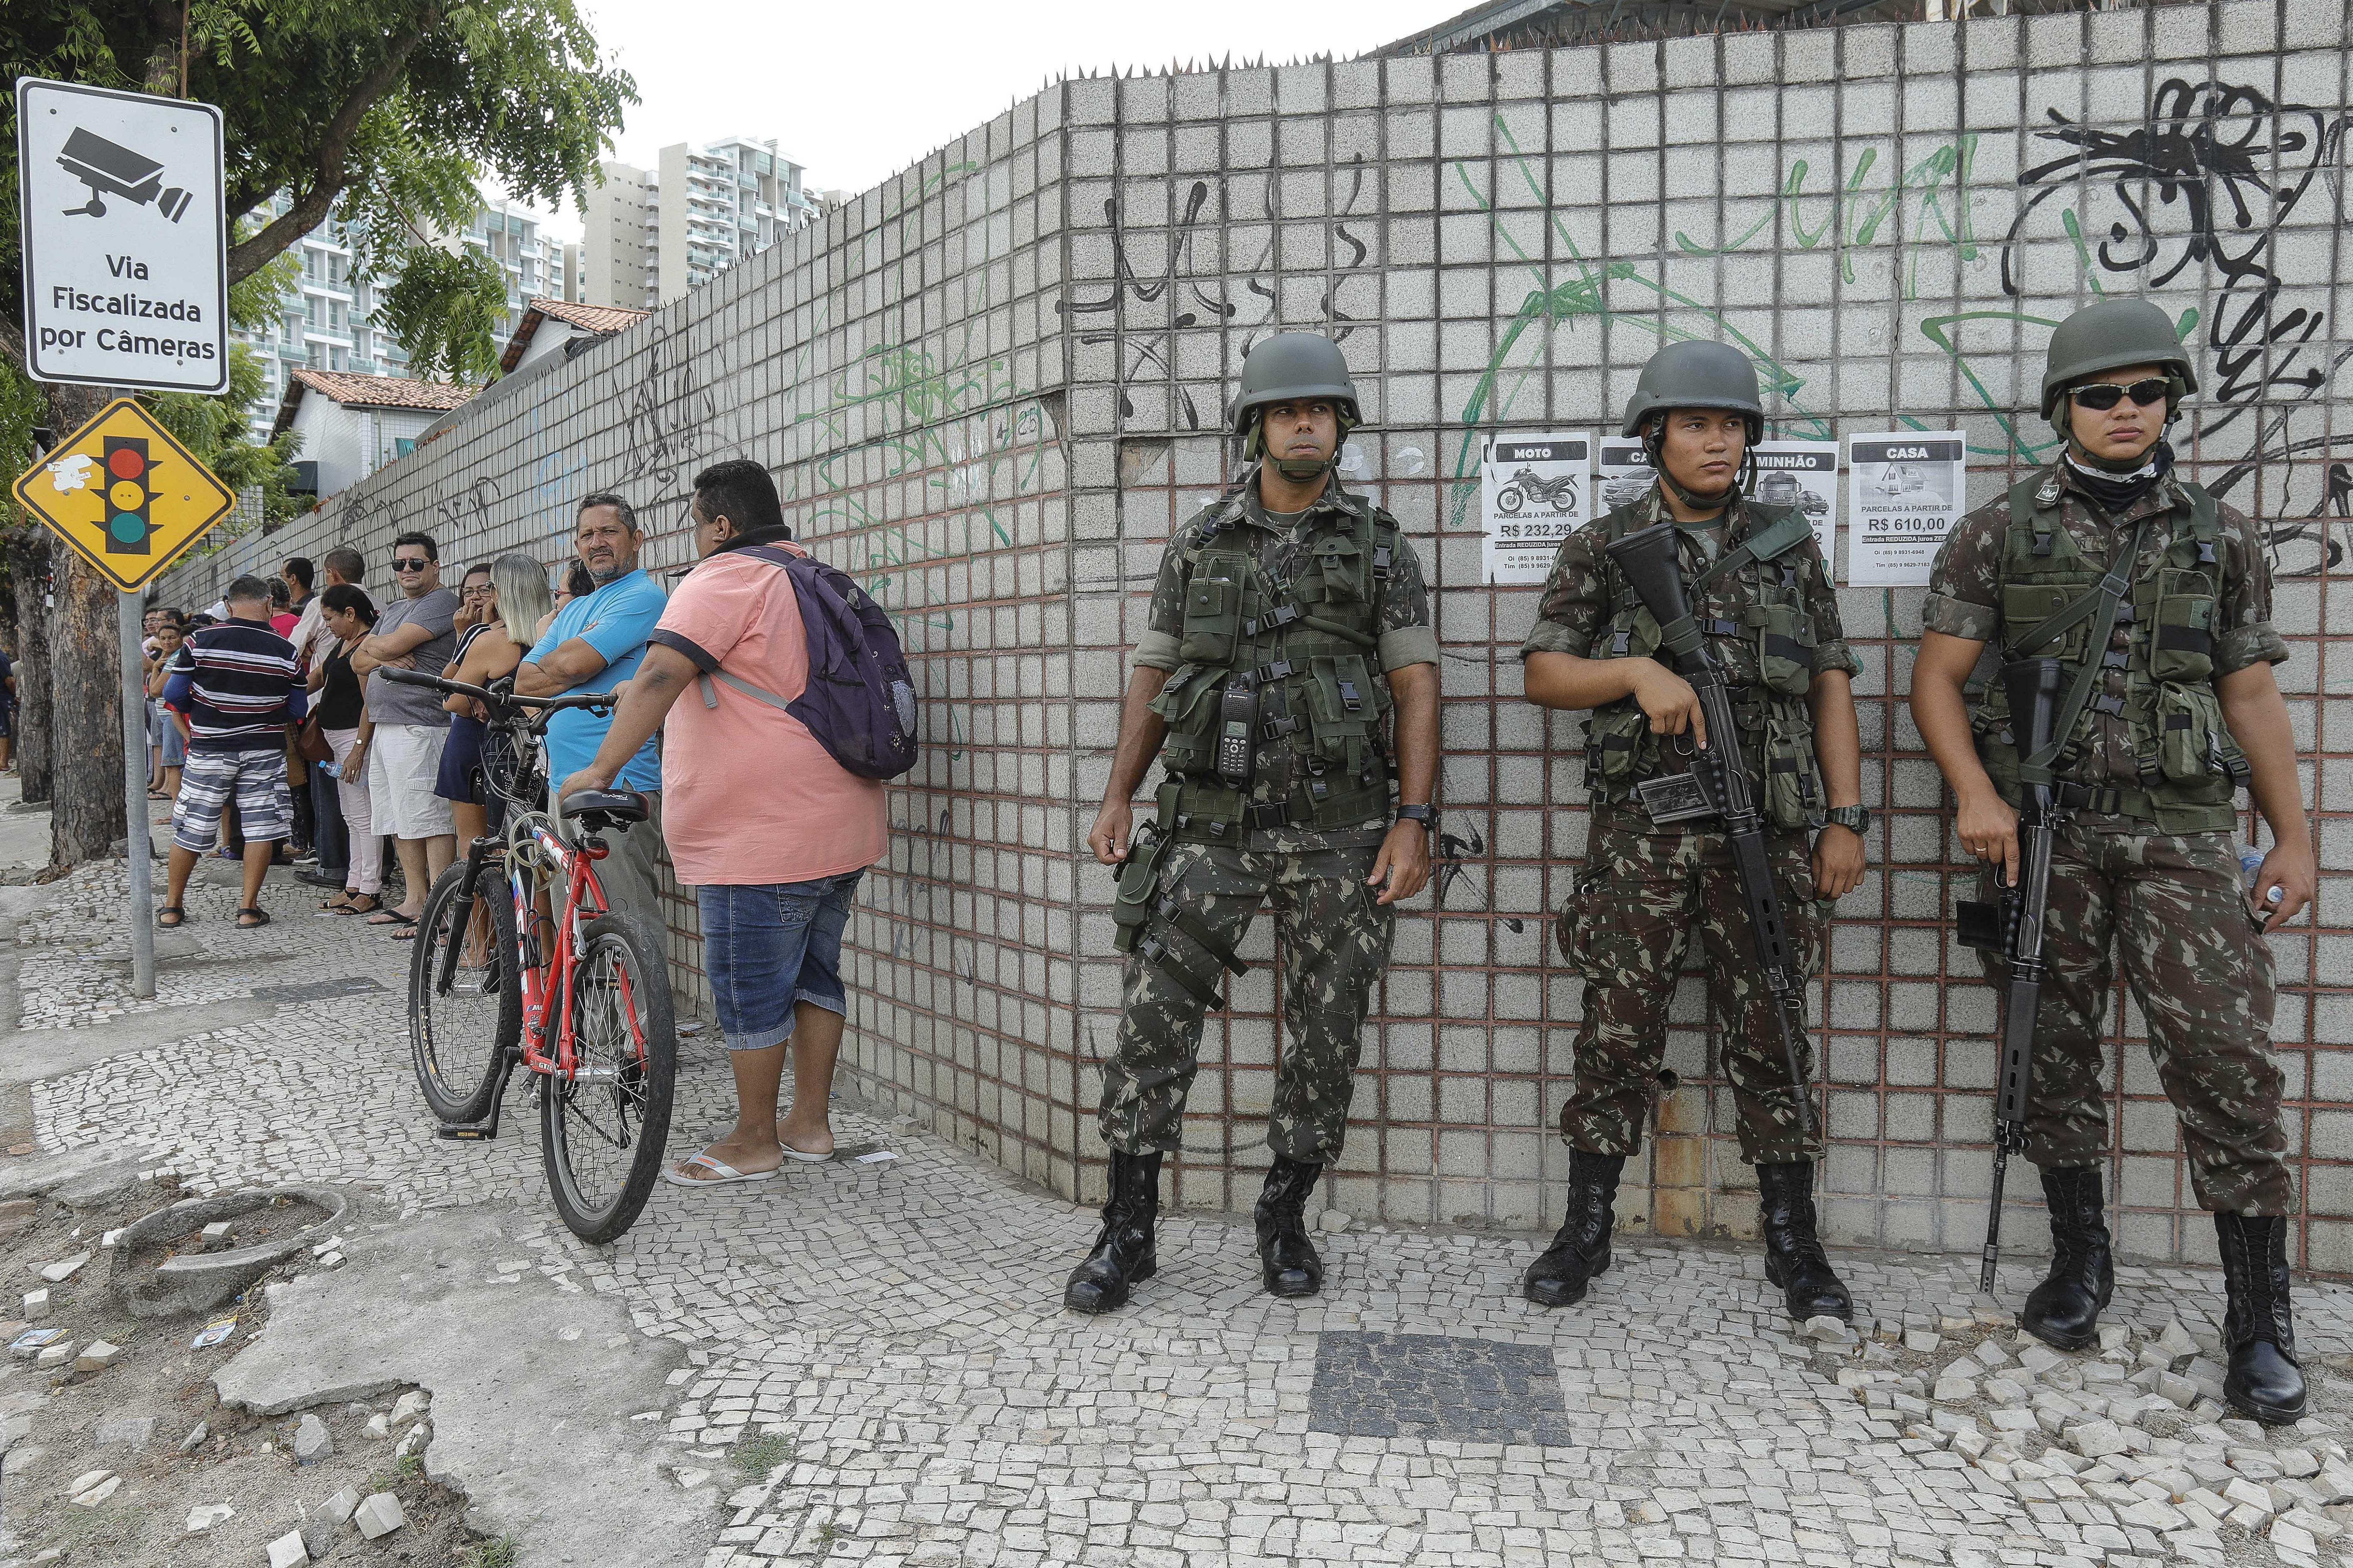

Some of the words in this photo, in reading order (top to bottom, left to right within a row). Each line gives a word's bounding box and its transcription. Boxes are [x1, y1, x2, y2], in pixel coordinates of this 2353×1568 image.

[106, 254, 148, 281] Via
[53, 286, 201, 322] Fiscalizada
[41, 326, 86, 351] por
[97, 329, 215, 360] Câmeras
[1514, 448, 1552, 459] MOTO
[1631, 452, 1648, 462] CA
[1887, 448, 1928, 459] CASA
[1756, 455, 1817, 467] MINHÃO
[1501, 524, 1520, 538] R$
[1525, 524, 1572, 538] 232,29
[1869, 518, 1889, 532] R$
[1894, 518, 1945, 532] 610,00
